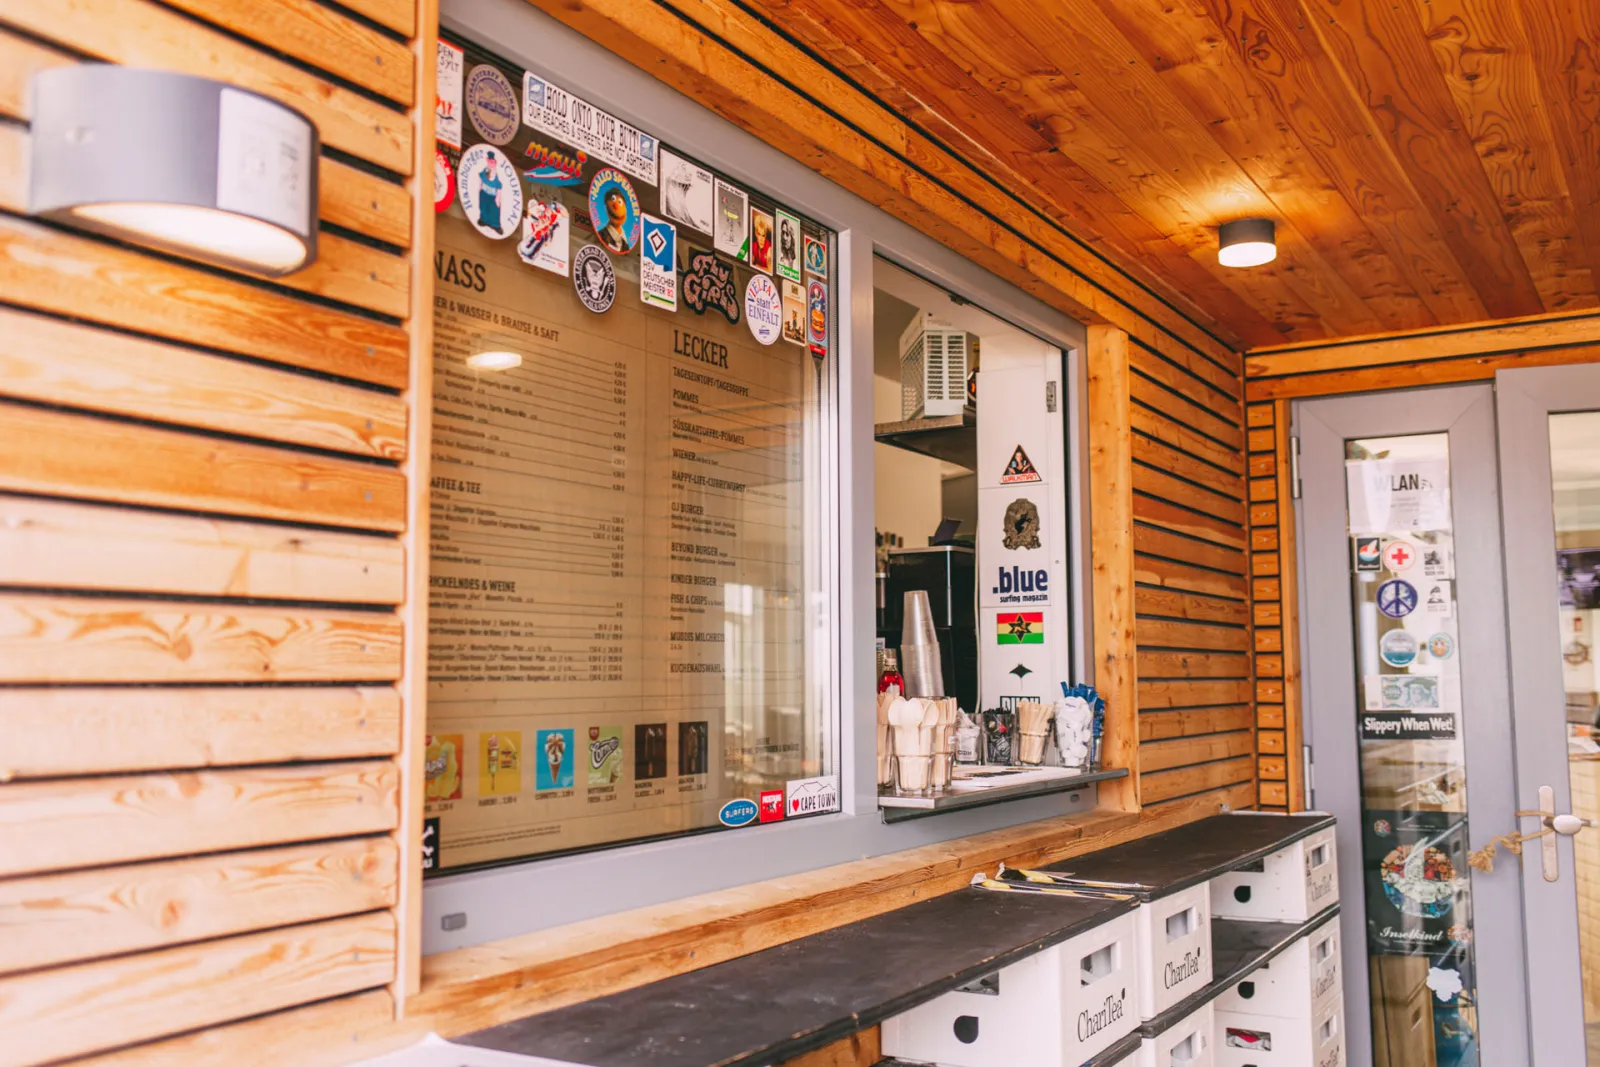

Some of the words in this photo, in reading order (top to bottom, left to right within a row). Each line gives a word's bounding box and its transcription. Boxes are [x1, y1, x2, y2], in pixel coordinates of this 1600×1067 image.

[546, 86, 568, 118] HOLD
[571, 99, 593, 130] ONTO
[596, 112, 616, 143] YOUR
[528, 103, 541, 120] OUR
[543, 110, 570, 136] BEACHES
[576, 126, 601, 151] STREETS
[603, 140, 613, 156] ARE
[615, 145, 625, 161] NOT
[525, 141, 587, 177] maui
[500, 160, 521, 226] JOURNAL
[591, 170, 613, 198] HALLO
[434, 250, 486, 293] NASS
[643, 270, 675, 287] DEUTSCHER
[643, 280, 666, 294] MEISTER
[457, 302, 492, 322] WASSER
[500, 315, 532, 334] BRAUSE
[540, 326, 559, 342] SAFT
[748, 305, 780, 327] EINFALT
[673, 329, 729, 370] LECKER
[672, 389, 699, 404] POMMES
[672, 448, 696, 462] WIENER
[466, 481, 481, 494] TEE
[680, 503, 704, 516] BURGER
[671, 541, 694, 554] BEYOND
[695, 545, 718, 557] BURGER
[489, 580, 516, 593] WEINE
[670, 573, 693, 585] KINDER
[693, 574, 717, 587] BURGER
[992, 565, 1048, 594] .blue
[670, 593, 684, 604] FISH
[690, 595, 708, 606] CHIPS
[999, 594, 1020, 604] surfing
[1022, 592, 1048, 602] magazin
[1364, 716, 1401, 734] Slippery
[1401, 717, 1430, 731] When
[800, 797, 816, 811] CAPE
[818, 792, 836, 809] TOWN
[1164, 951, 1198, 990] ChariTea
[1077, 994, 1124, 1043] ChariTea
